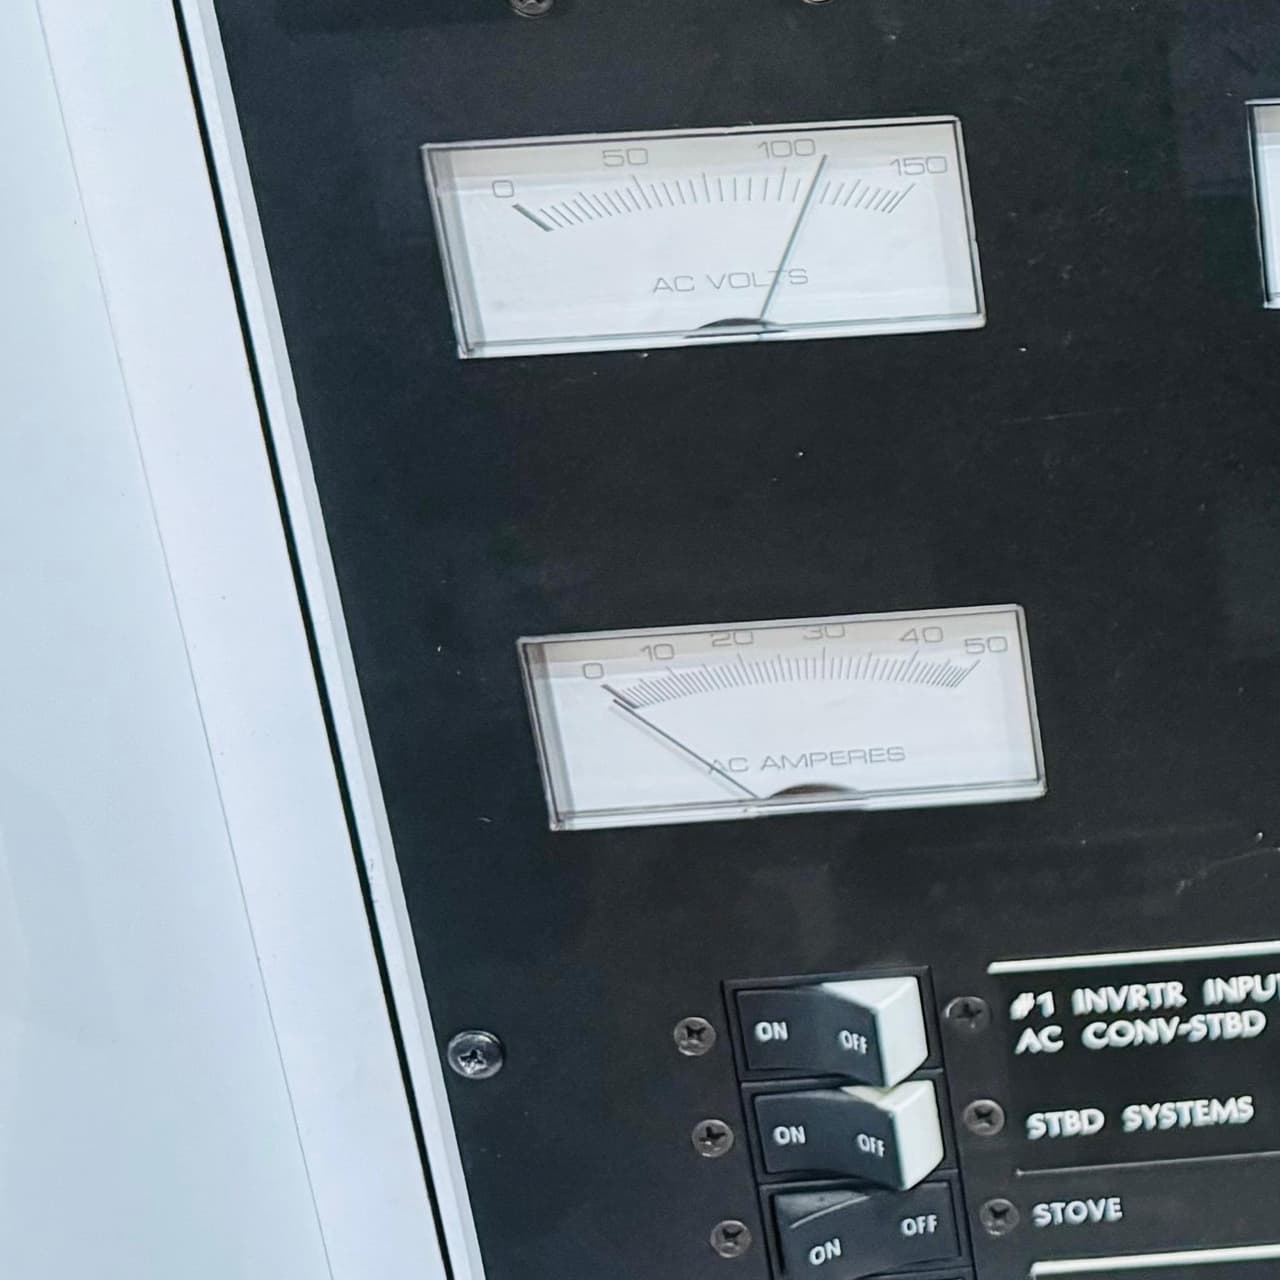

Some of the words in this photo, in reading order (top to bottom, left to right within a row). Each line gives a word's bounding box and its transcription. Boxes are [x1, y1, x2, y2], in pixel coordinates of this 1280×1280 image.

[602, 148, 649, 168] 50
[758, 138, 816, 159] 100
[889, 155, 948, 176] 150
[653, 275, 695, 293] AC
[706, 268, 809, 290] VOLTS
[710, 631, 753, 647] 20
[900, 627, 943, 644] 40
[965, 637, 1007, 655] 50
[640, 643, 675, 662] 10
[761, 746, 906, 771] AMPERES
[1010, 991, 1054, 1020] #1
[1072, 982, 1186, 1015] INVRTR
[755, 1022, 788, 1042] ON
[840, 1031, 867, 1055] OFF
[1016, 1026, 1064, 1055] AC
[1082, 1011, 1265, 1050] CONV-STBD
[1027, 1108, 1105, 1140] STBD
[1122, 1097, 1254, 1132] SYSTEMS
[774, 1125, 805, 1146] ON
[857, 1133, 886, 1158] OFF
[1033, 1198, 1122, 1227] STOVE
[902, 1215, 937, 1237] OFF
[810, 1239, 842, 1265] ON
